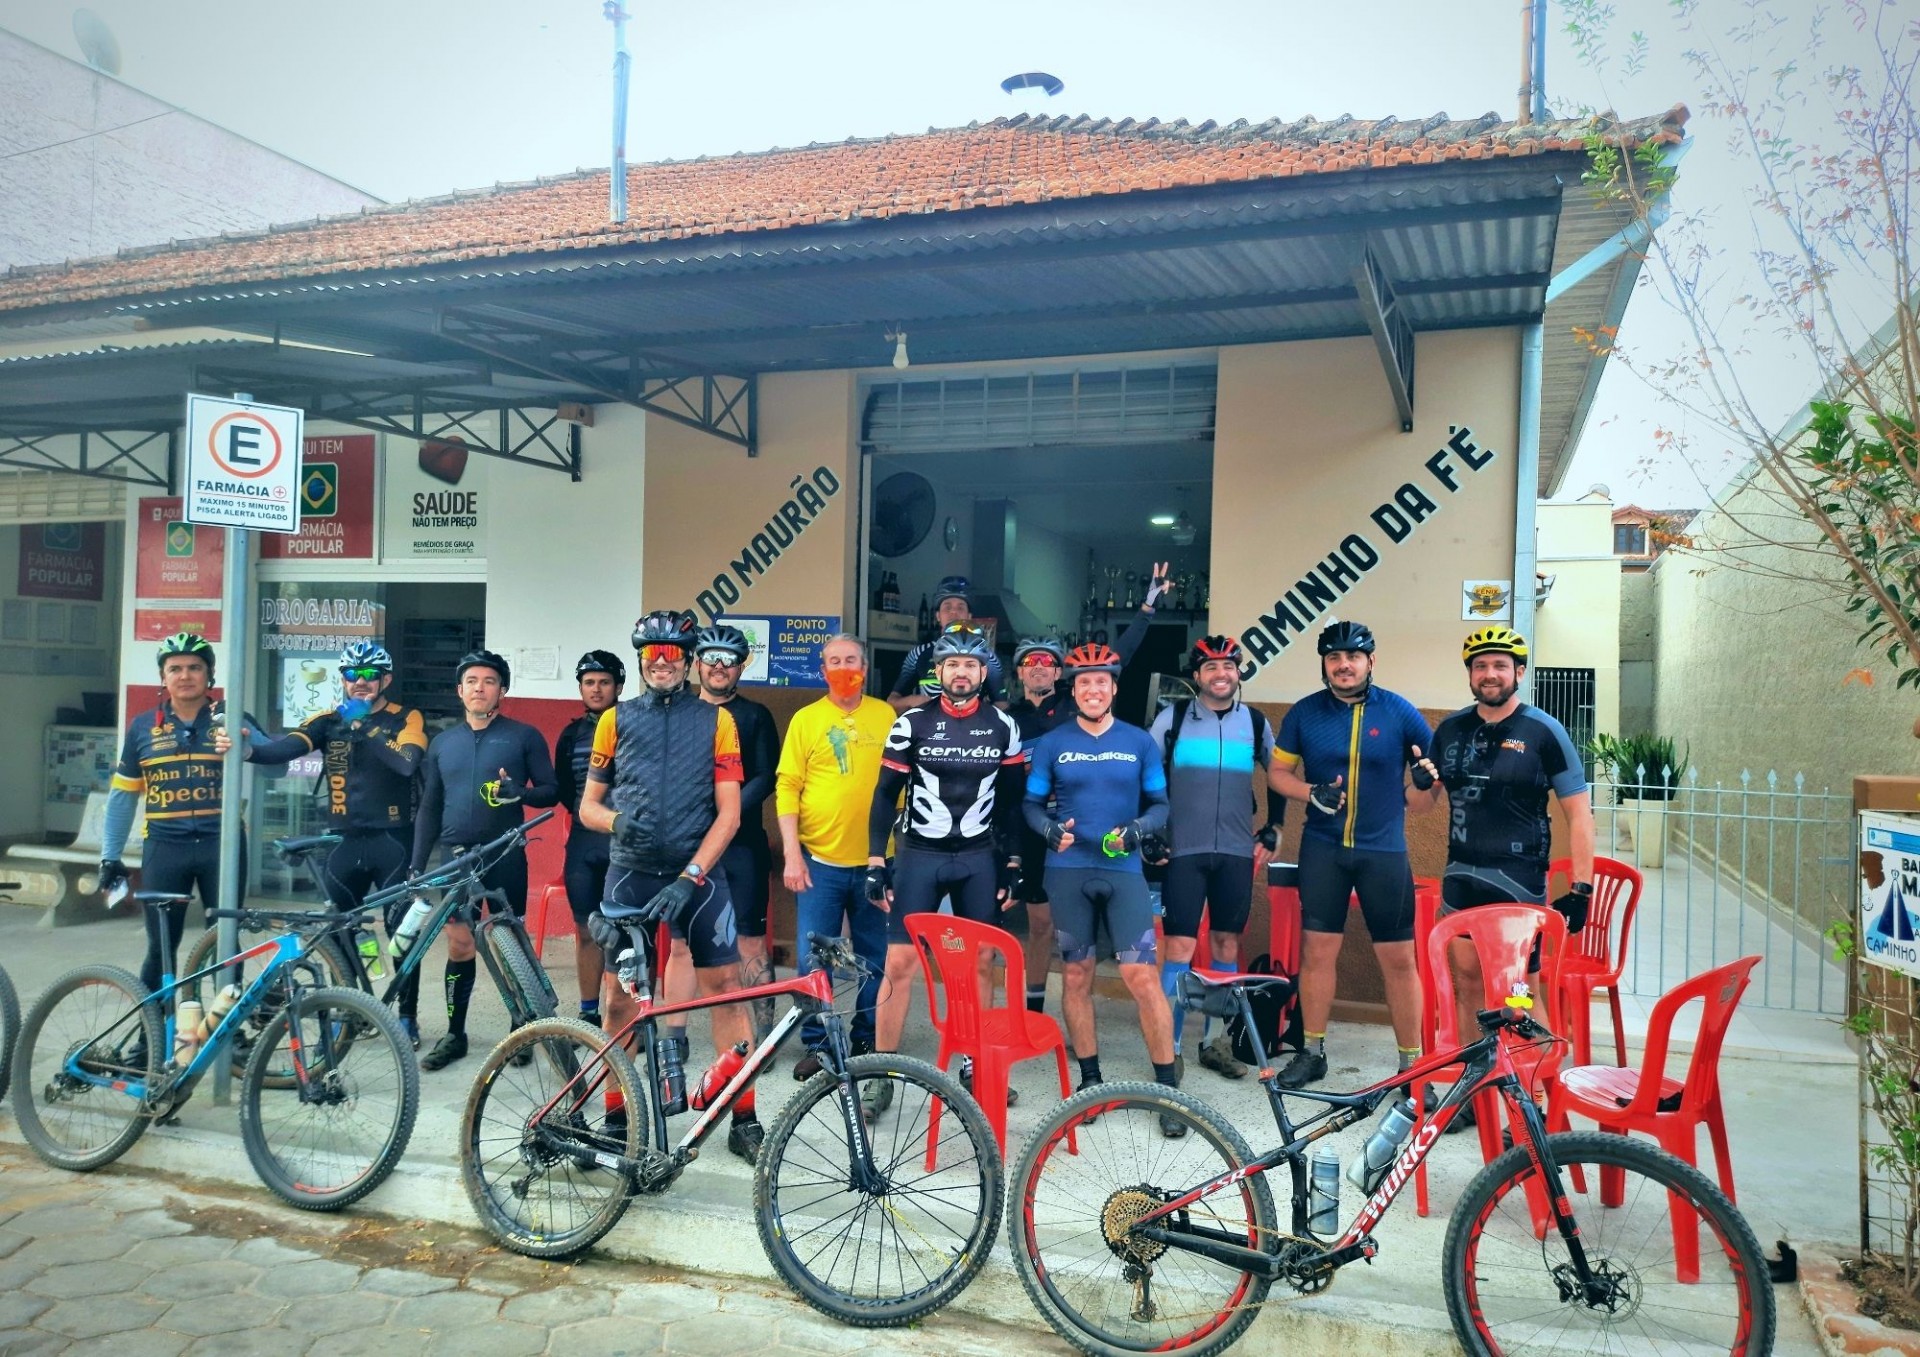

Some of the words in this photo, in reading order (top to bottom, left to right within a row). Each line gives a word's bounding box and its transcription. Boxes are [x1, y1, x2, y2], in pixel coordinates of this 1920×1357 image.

[229, 425, 261, 466] E
[302, 440, 316, 454] UI
[320, 440, 343, 454] TEM
[197, 480, 270, 497] FARMÁCIA
[1370, 482, 1437, 544] DA
[1424, 426, 1494, 493] FÉ
[248, 502, 286, 512] MINUTOS
[413, 490, 477, 515] SAÚDE
[196, 506, 222, 514] PISCA
[224, 508, 256, 518] ALERTA
[258, 512, 288, 520] LIGADO
[299, 520, 344, 536] RMÁCIA
[412, 515, 430, 527] NÃO
[432, 517, 449, 527] TEM
[450, 516, 476, 529] PREÇO
[288, 540, 344, 554] POPULAR
[454, 540, 474, 549] GRAÇA
[696, 573, 740, 622] DO
[730, 466, 840, 587] MAURÃO
[28, 568, 92, 586] POPULAR
[162, 572, 198, 582] POPULAR
[262, 598, 372, 626] DROGARIA
[786, 619, 826, 630] PONTO
[779, 633, 795, 643] DE
[918, 746, 1001, 758] cervélo
[1902, 857, 1920, 874] BA
[1902, 874, 1920, 898] M
[1866, 936, 1916, 963] CAMINHO
[846, 1096, 864, 1158] manitou
[1348, 1124, 1438, 1241] S-WORKS
